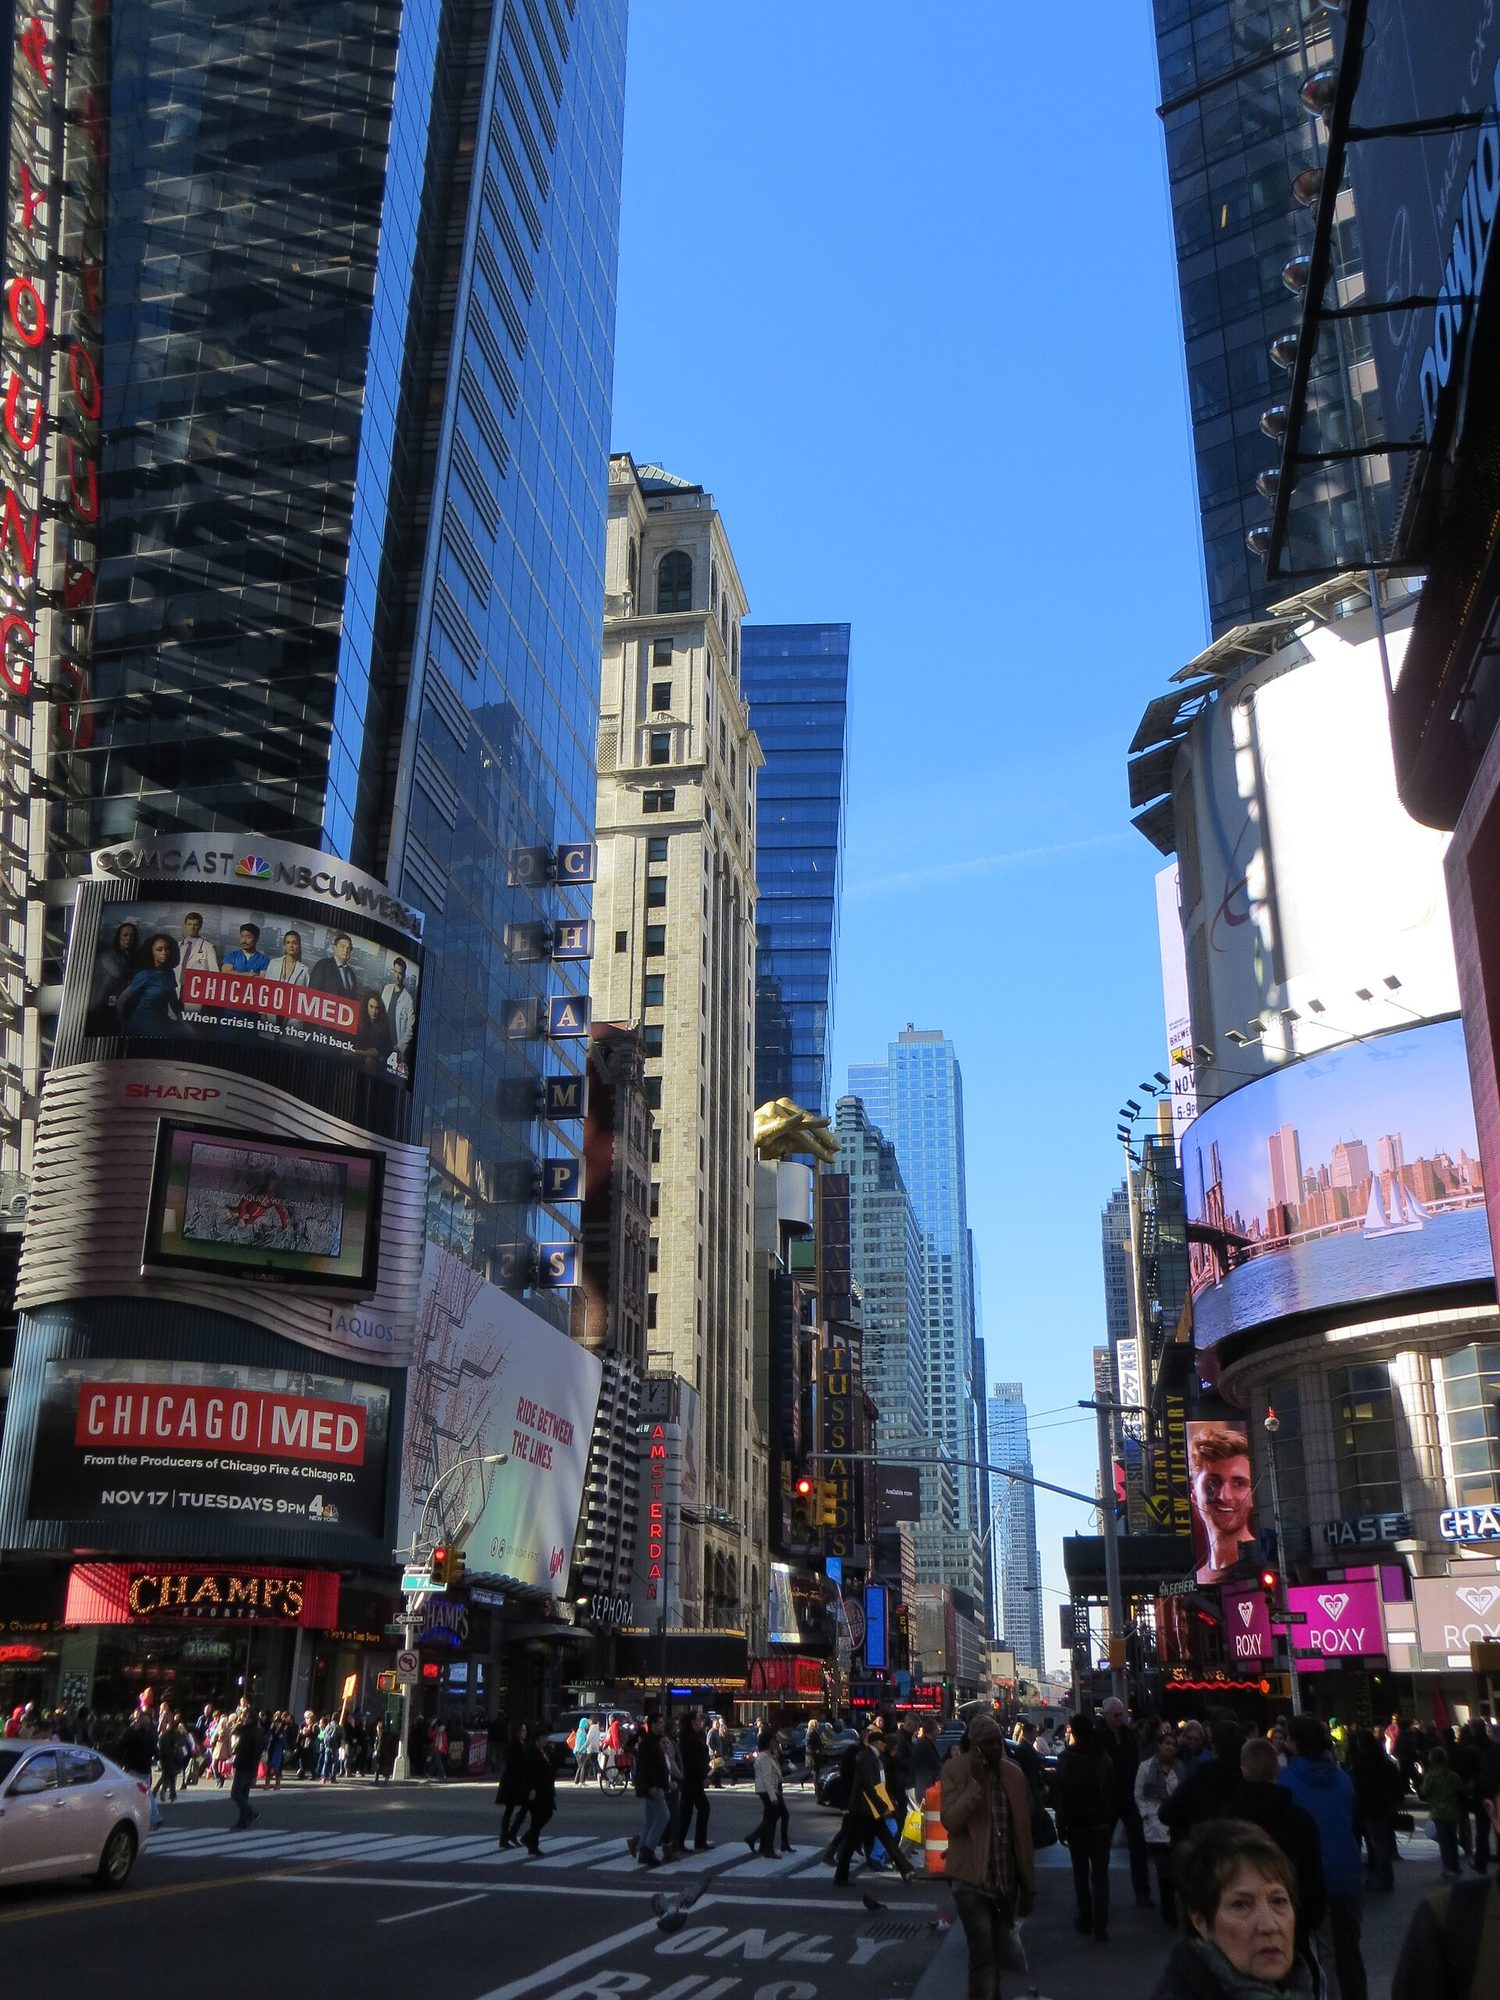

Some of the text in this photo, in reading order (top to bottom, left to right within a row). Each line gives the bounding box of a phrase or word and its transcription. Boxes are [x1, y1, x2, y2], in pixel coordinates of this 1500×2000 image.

[97, 849, 423, 939] COMCAST NBCUNIVERS
[190, 975, 355, 1028] CHICAGO MED
[181, 1011, 356, 1053] When crisis hits, they hit back.
[386, 1051, 399, 1071] 4
[549, 850, 585, 1277] CHAMPS
[125, 1083, 221, 1101] SHARP
[335, 1314, 393, 1342] AQUOS
[1120, 1343, 1138, 1371] NEW
[88, 1395, 359, 1453] CHICAGO MED
[516, 1396, 575, 1447] RIDE BETWEEN
[512, 1430, 554, 1472] THE LINES.
[1166, 1395, 1188, 1484] VICTORY
[84, 1454, 356, 1483] From the Producers of Chicago Fire & Chicago P.D.
[102, 1490, 305, 1515] NOV 17 TUESDAYS 9PM
[308, 1495, 324, 1516] 4
[550, 1545, 564, 1579] lyft
[129, 1575, 303, 1617] CHAMPS
[182, 1606, 258, 1619] SPORTS
[590, 1594, 634, 1625] SEPHORA
[417, 1602, 469, 1641] CHAMPS
[1235, 1633, 1262, 1656] ROXY
[1310, 1627, 1366, 1652] ROXY
[653, 1926, 905, 1965] ONLY
